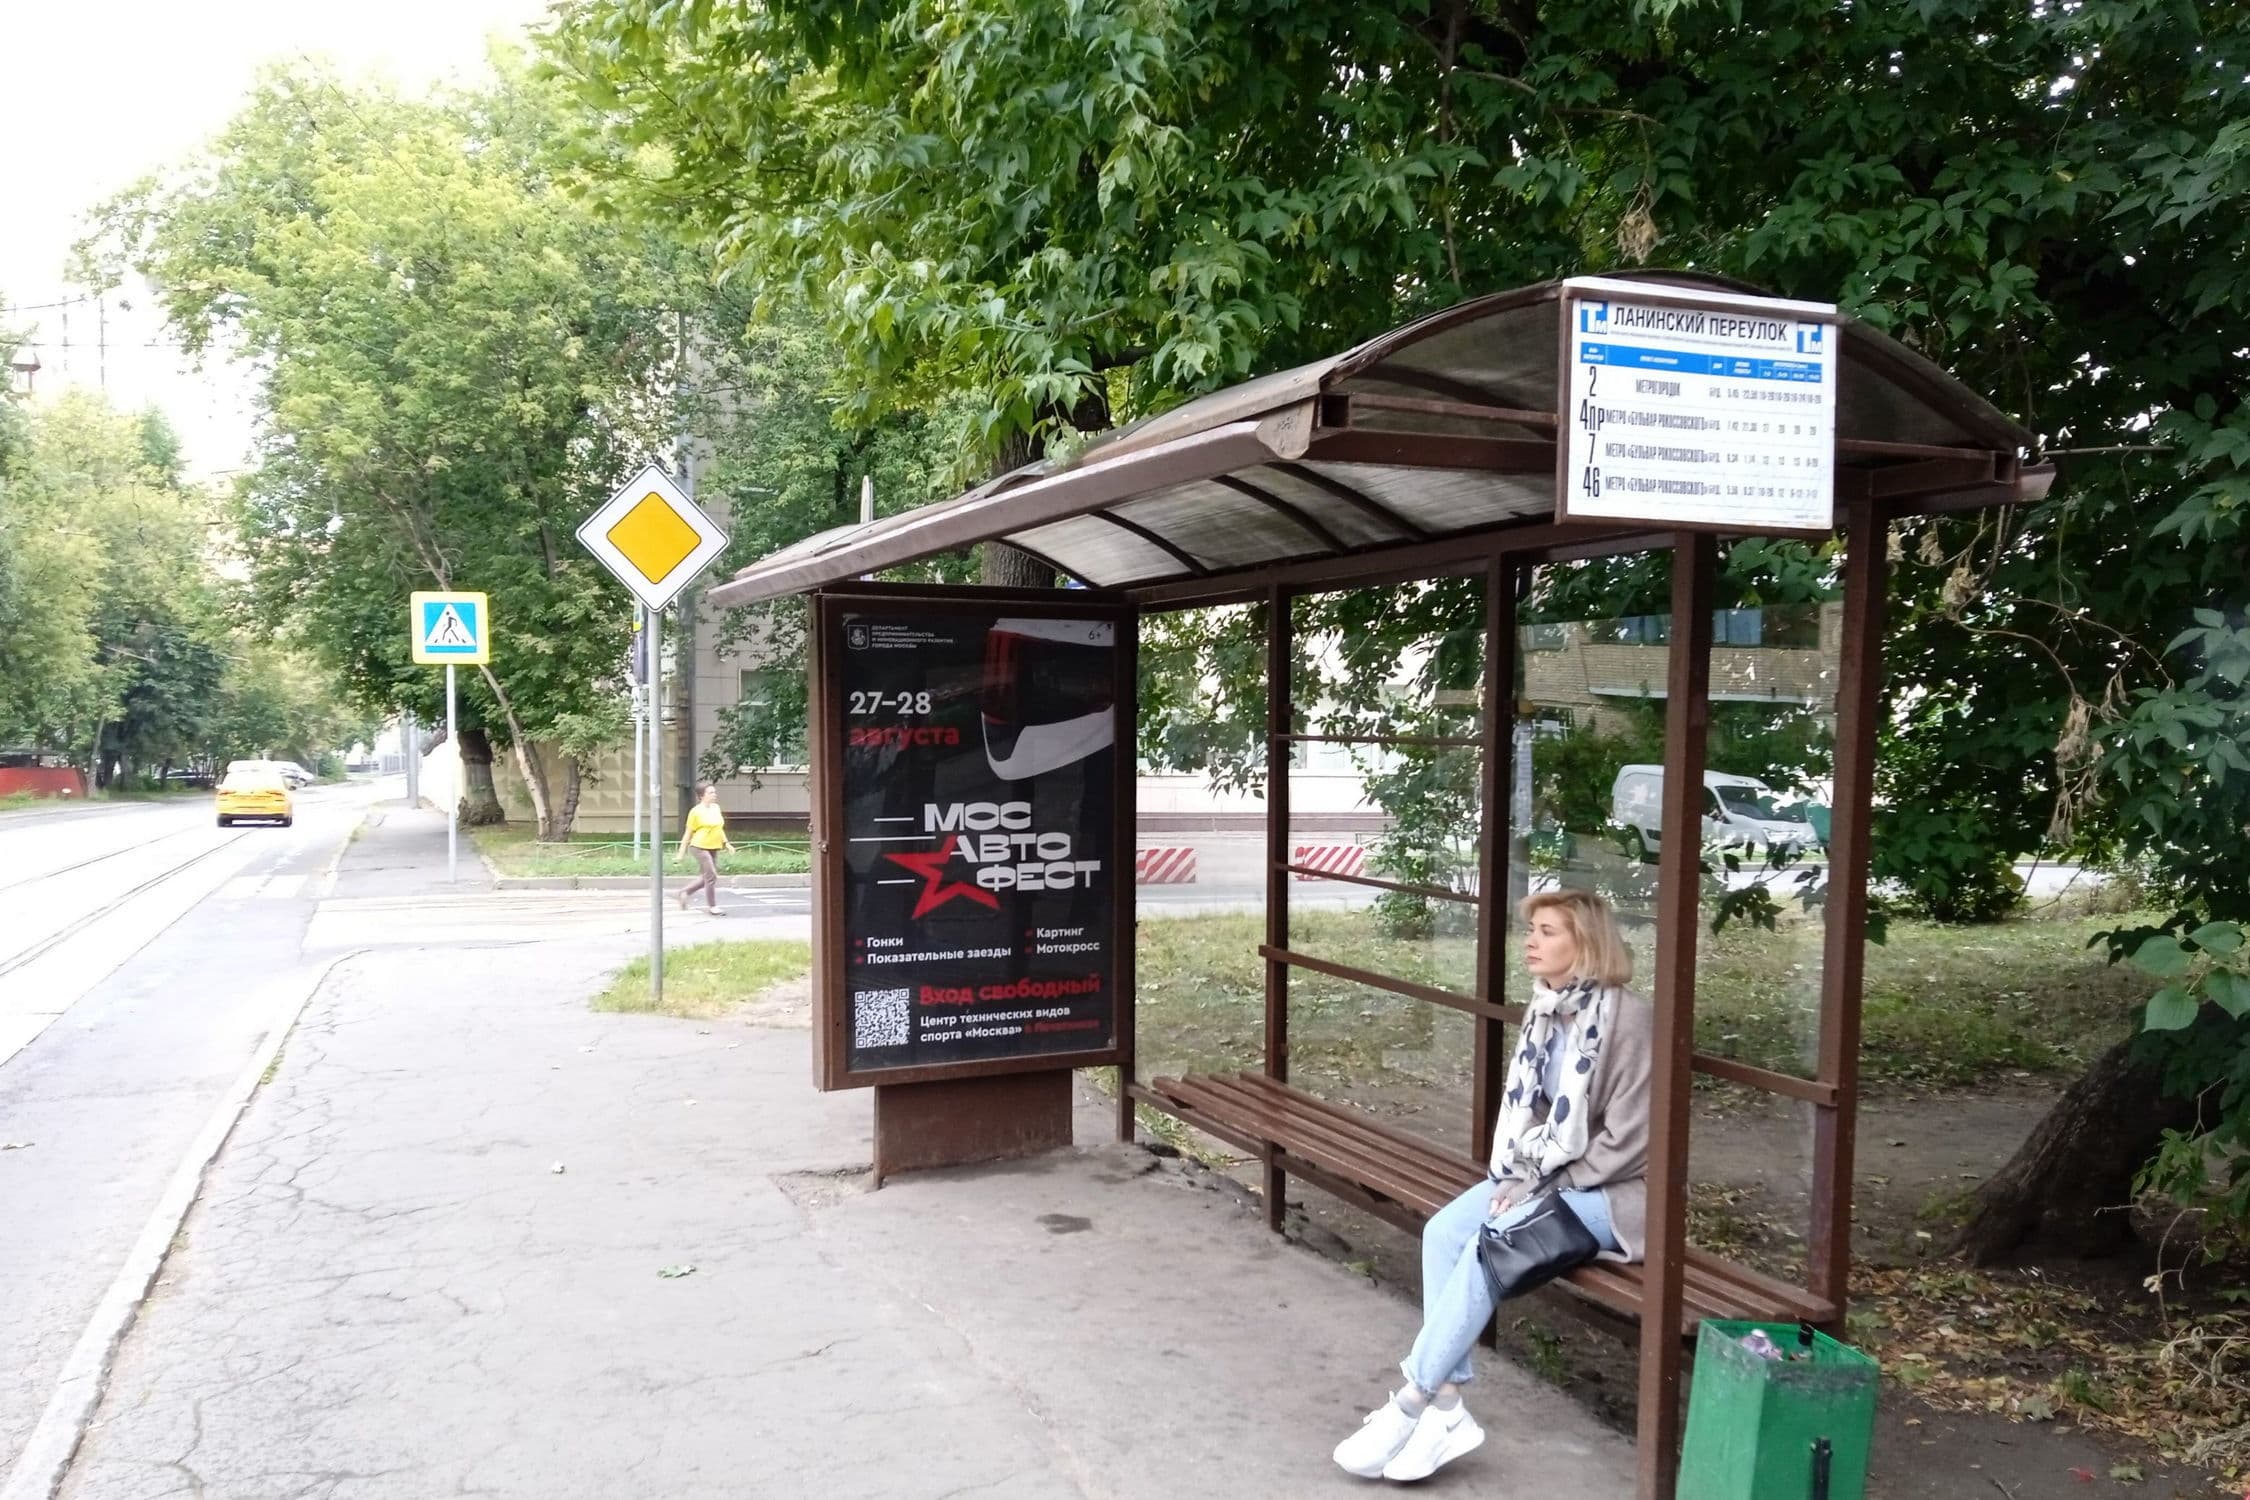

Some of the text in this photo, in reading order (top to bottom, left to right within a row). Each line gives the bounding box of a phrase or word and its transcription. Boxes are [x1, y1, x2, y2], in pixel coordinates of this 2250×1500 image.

[1614, 307, 1705, 334] ЛАНИНСКИЙ
[1709, 317, 1788, 342] ПЕРЕУЛОК
[1589, 366, 1597, 397] 2
[1588, 433, 1596, 464] 7
[1583, 466, 1600, 497] 46
[850, 726, 959, 750] августа
[924, 801, 1031, 833] МОС
[949, 832, 1071, 863] АВТО
[976, 860, 1101, 892] ФЕСТ
[867, 937, 904, 948] Гонки
[1036, 927, 1085, 939] Картинг
[1036, 941, 1100, 954] Мотокросс
[867, 947, 1012, 965] Показательные заезды
[919, 972, 1101, 1006] Вход свободный
[920, 1006, 1071, 1028] Центр технических видов
[920, 1029, 962, 1042] спорта
[965, 1025, 1022, 1038] «Москва»
